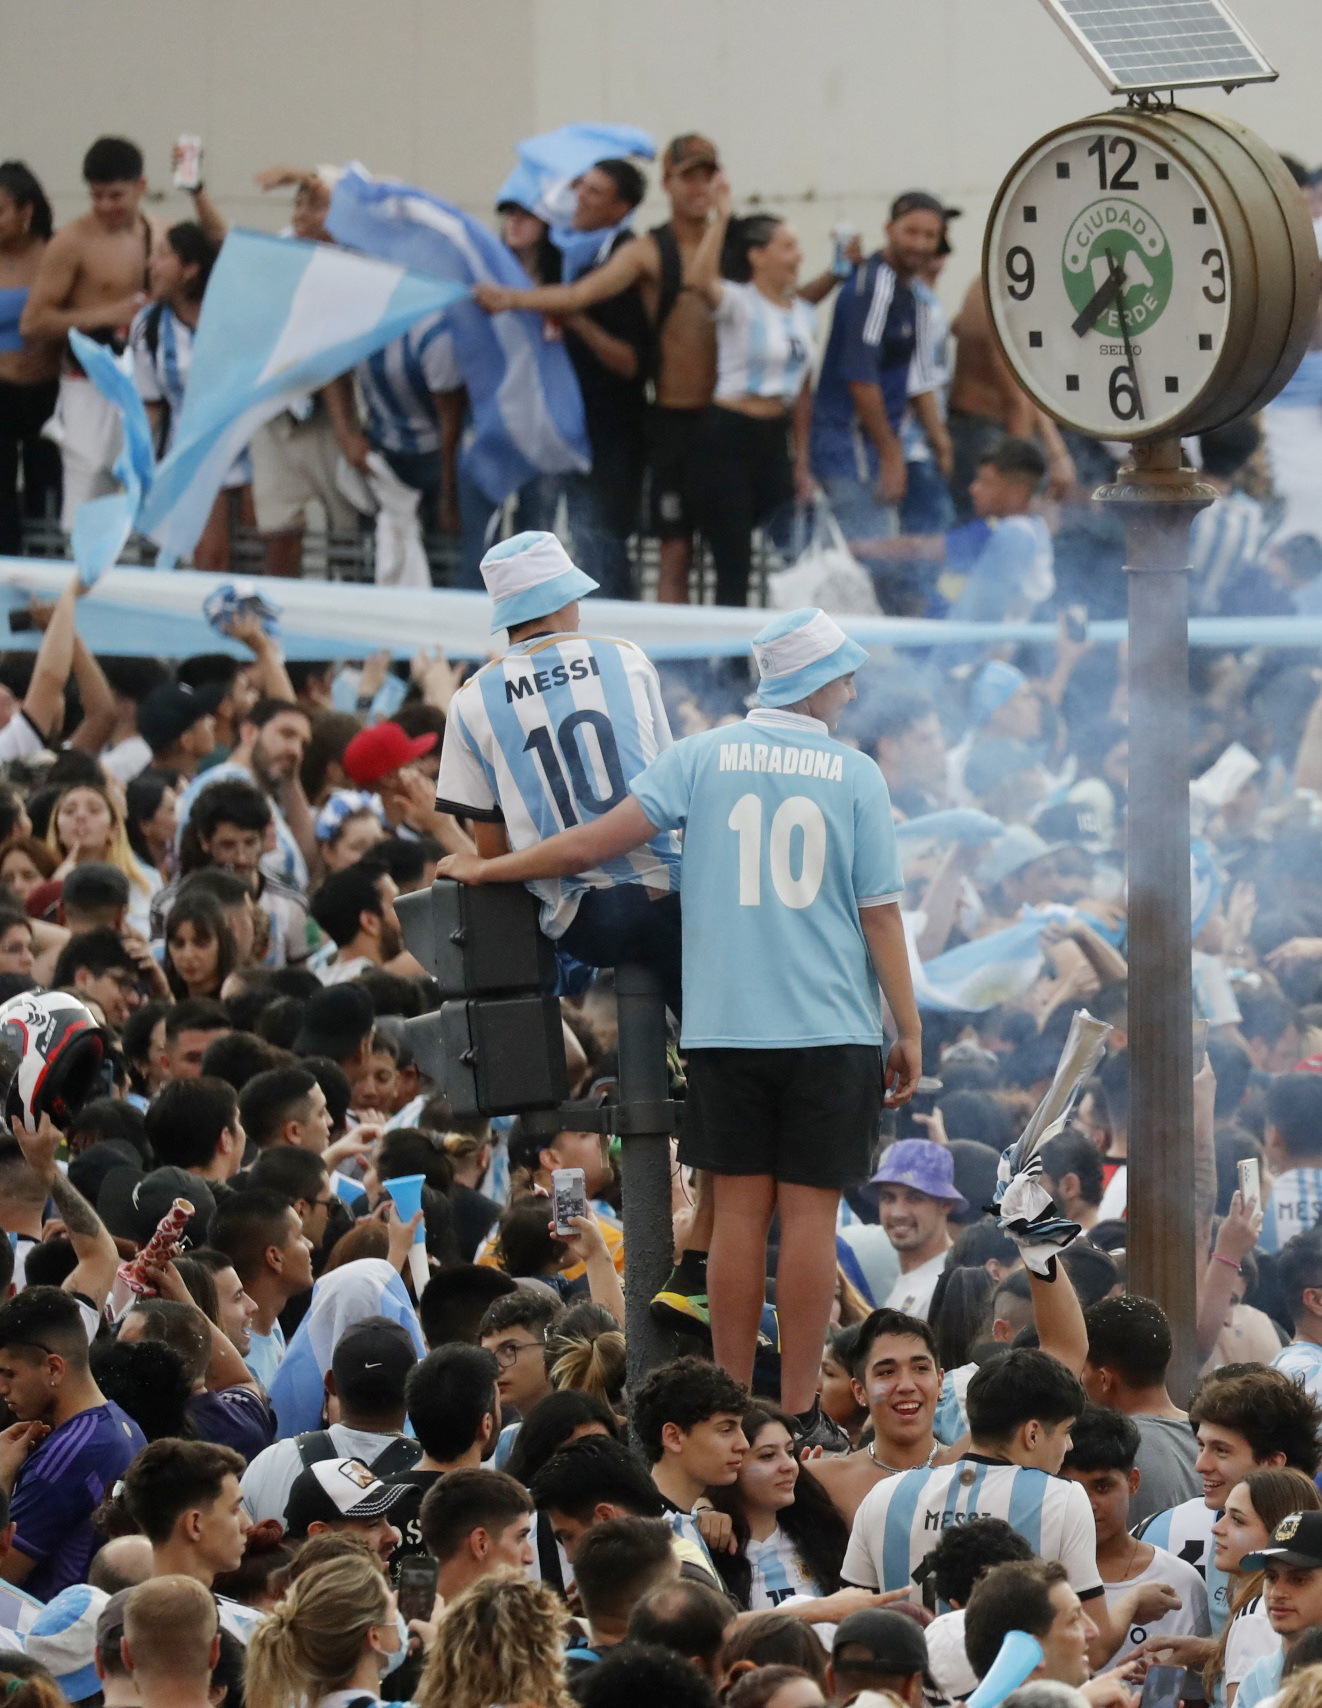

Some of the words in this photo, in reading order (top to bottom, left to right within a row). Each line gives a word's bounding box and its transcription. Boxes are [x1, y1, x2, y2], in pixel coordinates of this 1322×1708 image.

[1088, 134, 1139, 191] 12
[1076, 207, 1146, 248] CIUDAD
[1005, 245, 1035, 301] 9
[1201, 248, 1226, 304] 3
[1108, 365, 1139, 421] 6
[504, 656, 601, 704] MESSI
[522, 709, 630, 829] 10
[718, 743, 844, 783] MARADONA
[727, 793, 827, 910] 10
